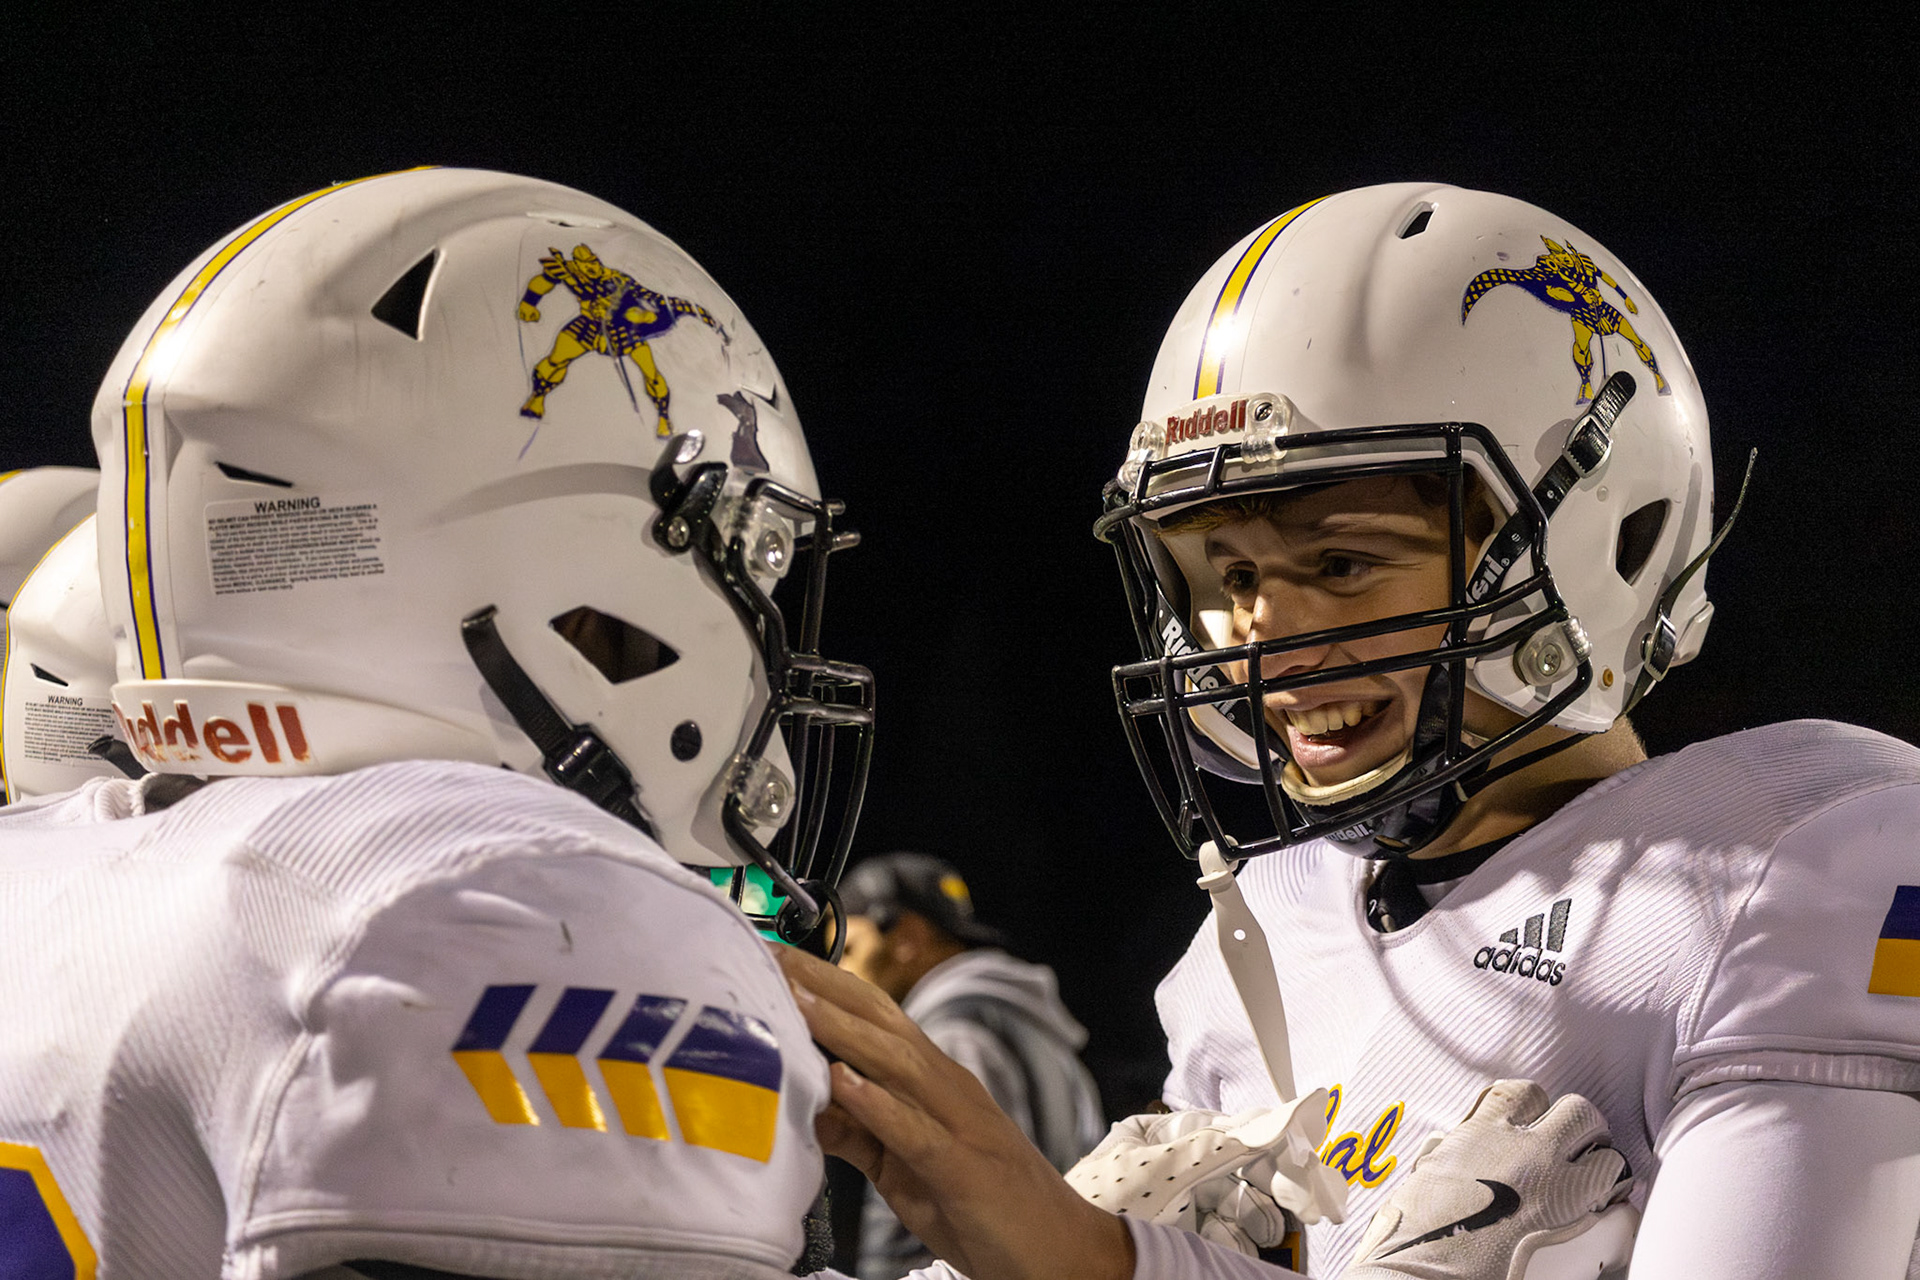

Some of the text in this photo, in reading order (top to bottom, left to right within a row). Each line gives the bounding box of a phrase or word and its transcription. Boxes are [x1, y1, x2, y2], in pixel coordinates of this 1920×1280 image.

[1165, 400, 1247, 446] Riddell
[254, 497, 320, 513] WARNING
[48, 695, 83, 706] WARNING
[1474, 944, 1565, 986] adidas
